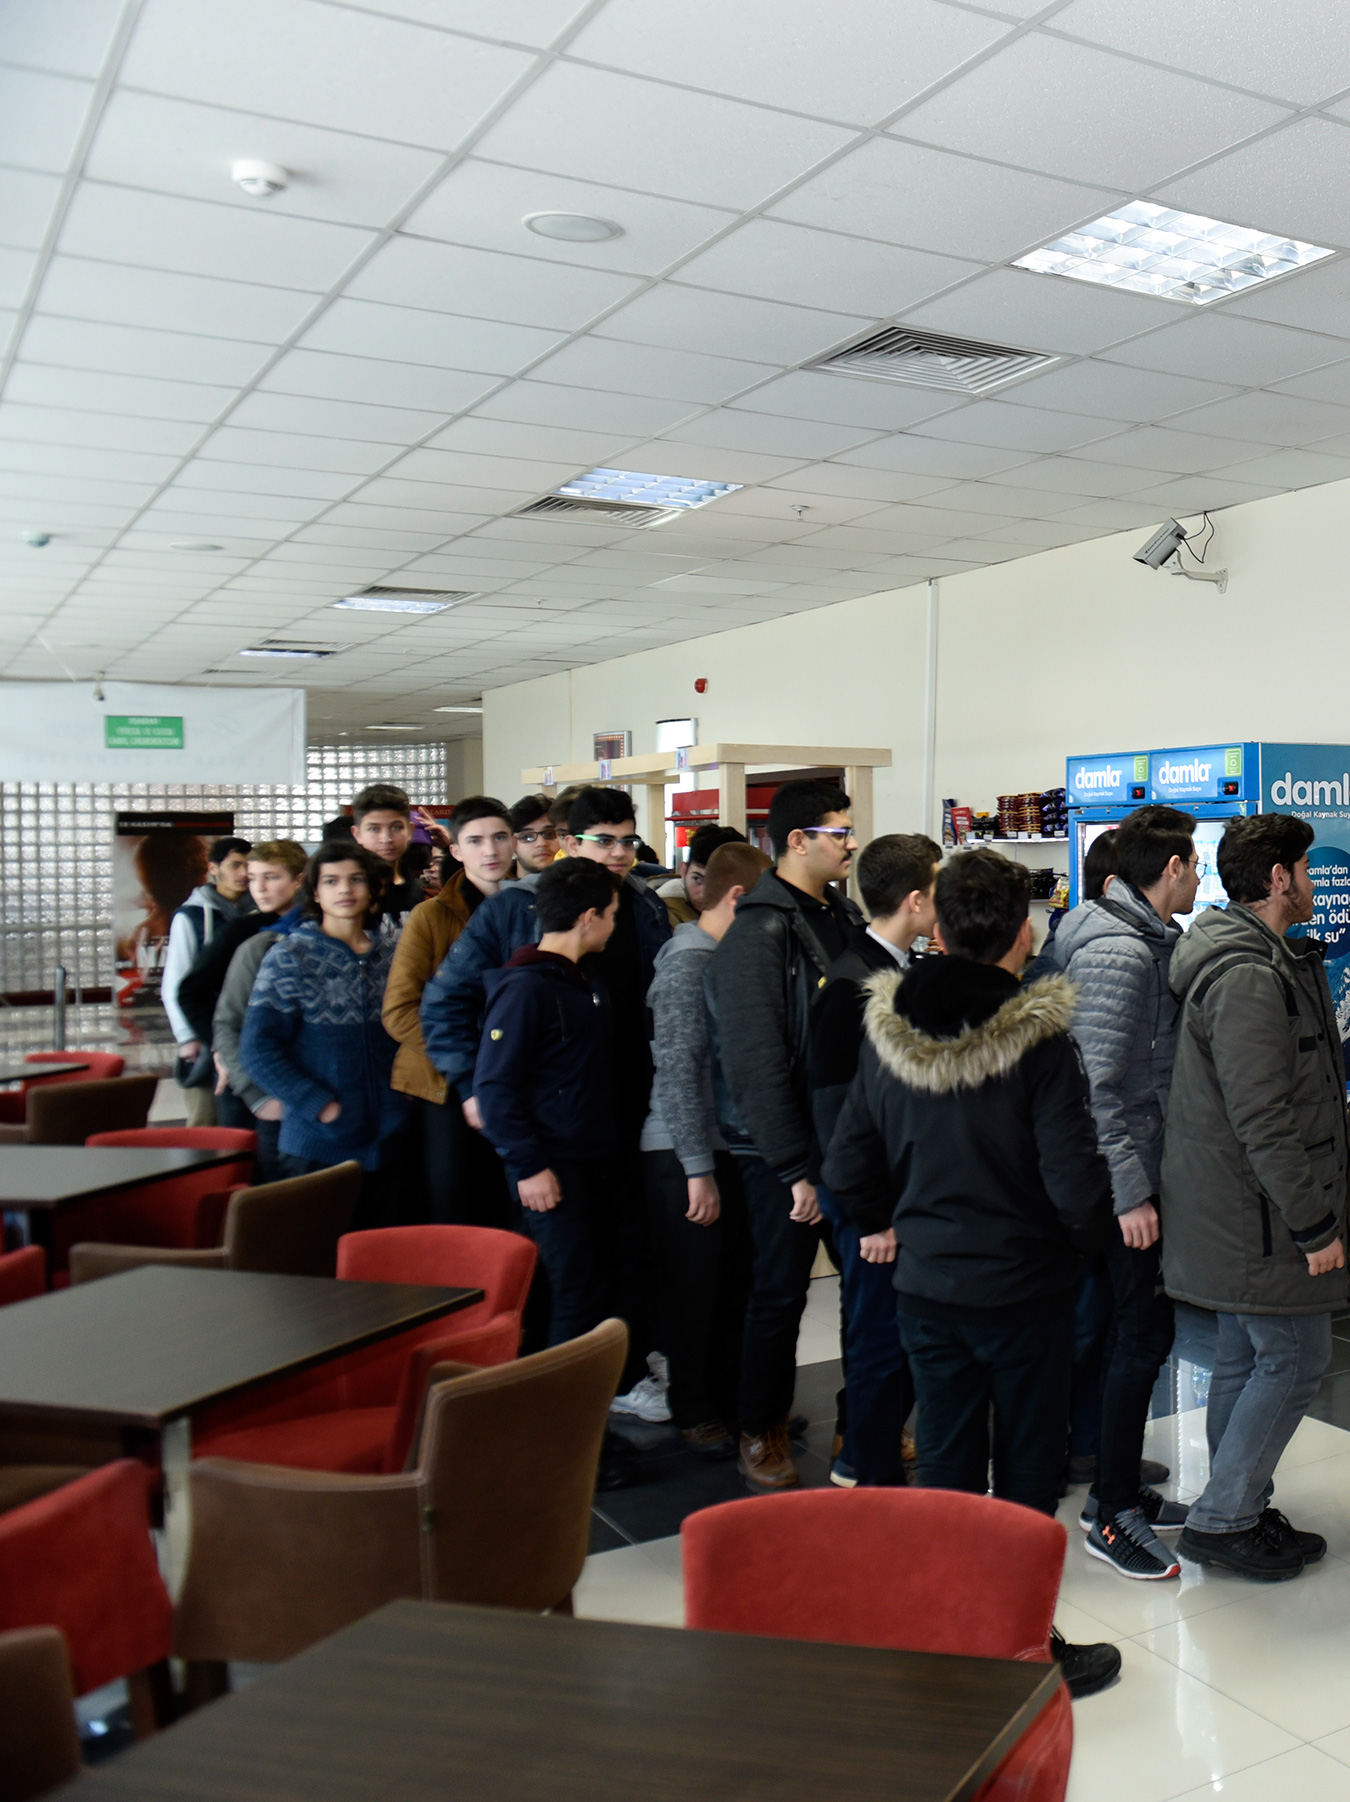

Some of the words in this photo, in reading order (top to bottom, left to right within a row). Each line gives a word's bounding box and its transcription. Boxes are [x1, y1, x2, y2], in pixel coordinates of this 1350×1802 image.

[1075, 764, 1121, 790] damla
[1158, 758, 1211, 785] damla
[1291, 810, 1312, 819] Doğal
[1313, 810, 1338, 820] Kaynak
[1306, 864, 1349, 876] amla'dan
